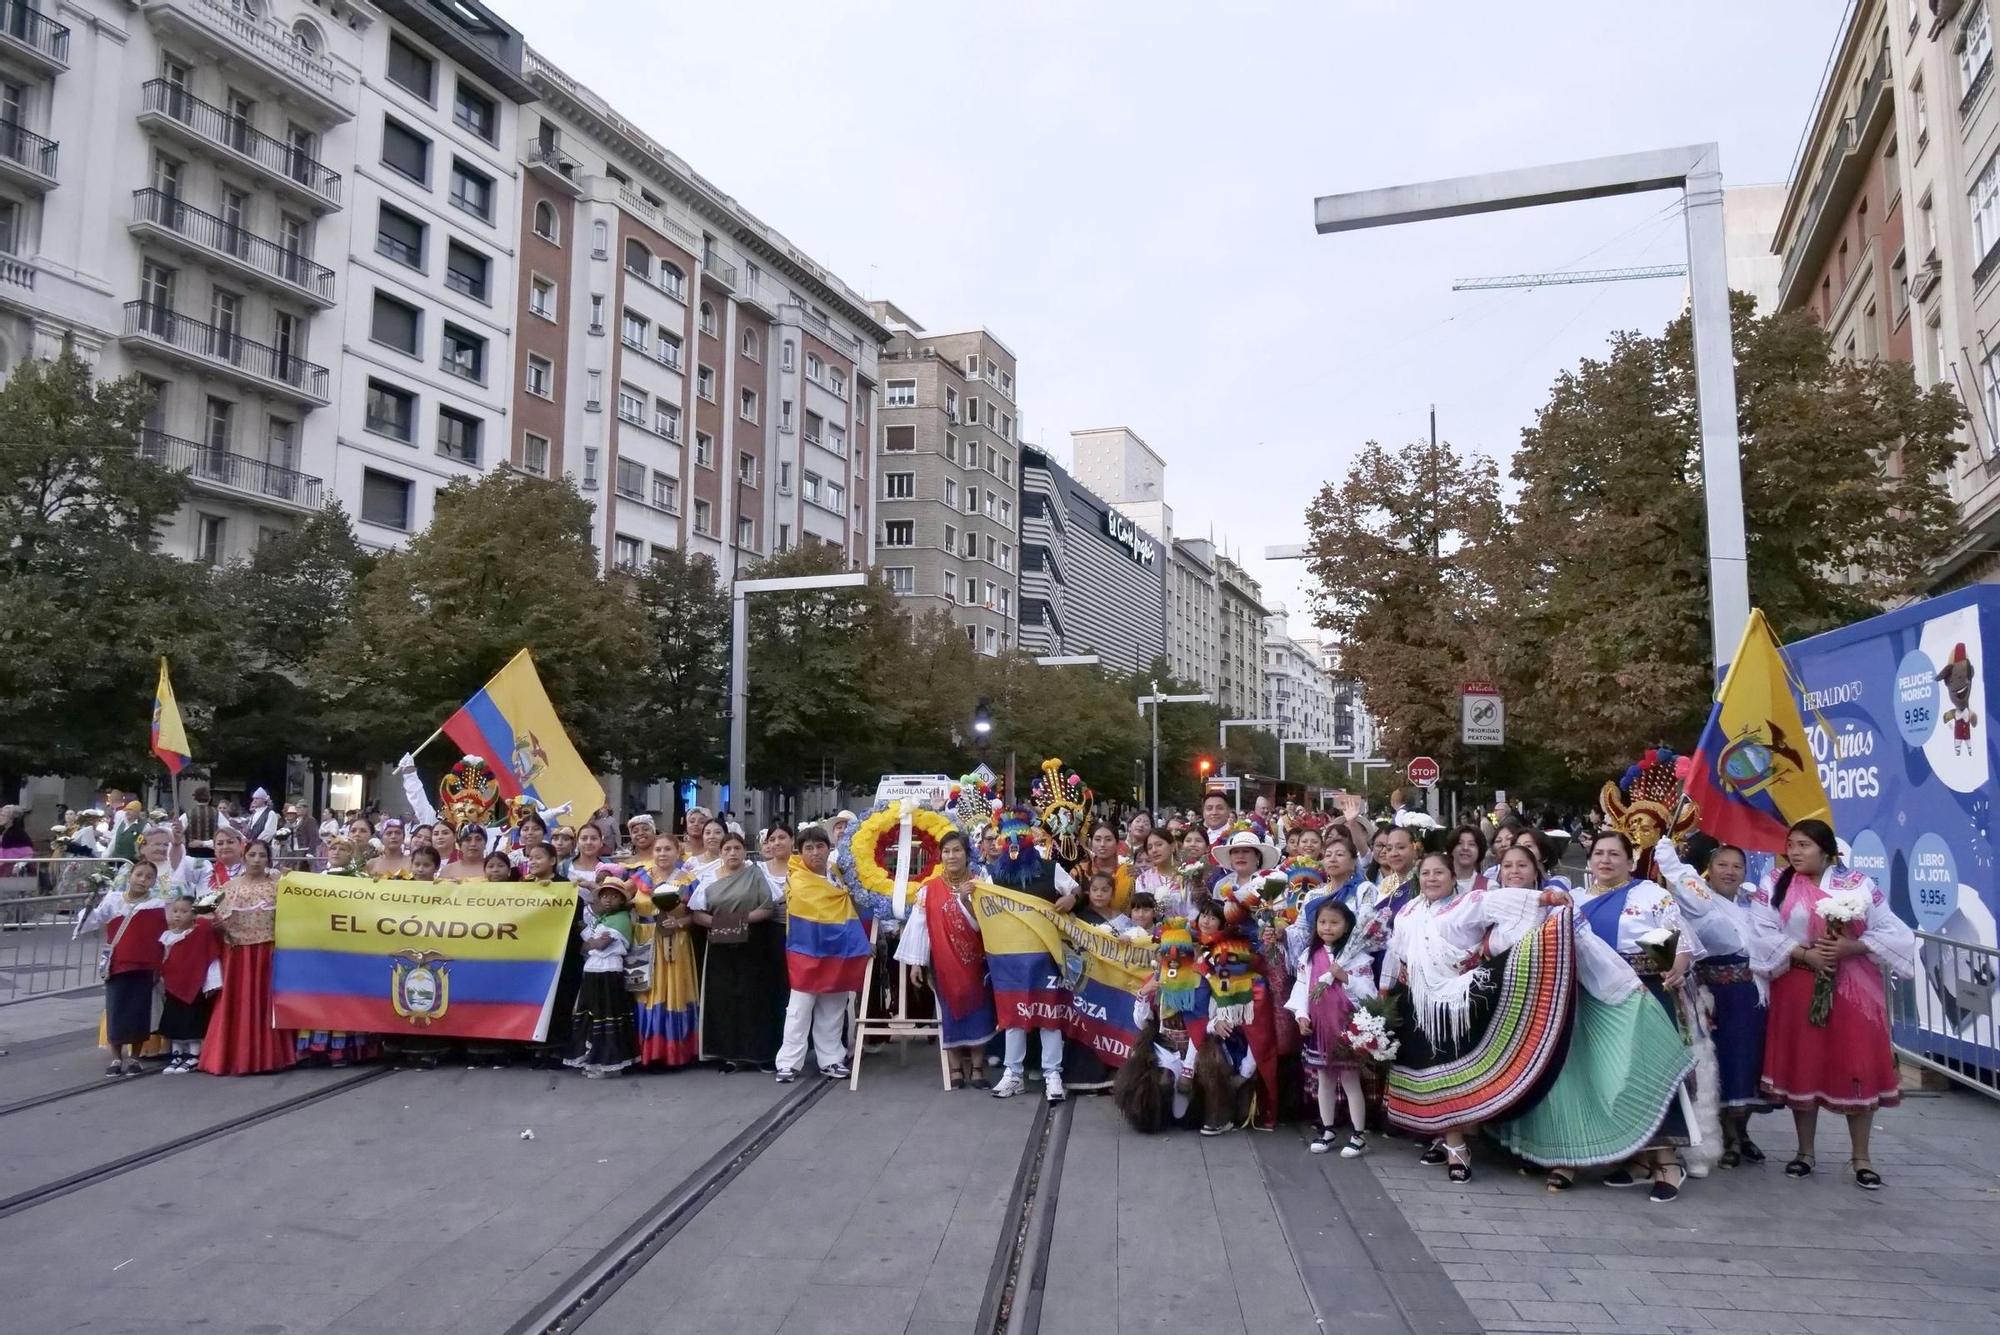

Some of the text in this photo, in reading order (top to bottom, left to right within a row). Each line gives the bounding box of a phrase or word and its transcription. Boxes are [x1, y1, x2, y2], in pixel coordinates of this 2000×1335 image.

[1109, 510, 1116, 537] El
[1899, 671, 1933, 690] PELUCHE
[1803, 684, 1850, 711] HERALDO
[1901, 686, 1931, 702] MORICO
[1904, 707, 1930, 726] 9,95€
[1411, 768, 1436, 776] STOP
[1817, 760, 1880, 800] Pilares
[1854, 856, 1885, 869] BROCHE
[1918, 853, 1945, 867] LIBRO
[1914, 868, 1951, 882] LA JOTA
[283, 886, 574, 907] ASOCIACIÓN CULTURAL ECUATORIANA
[1920, 889, 1946, 907] 9,95€
[331, 914, 518, 940] EL CÓNDOR
[1101, 937, 1120, 963] DEL
[1124, 941, 1157, 969] QUIN
[1093, 1034, 1131, 1059] ANDI
